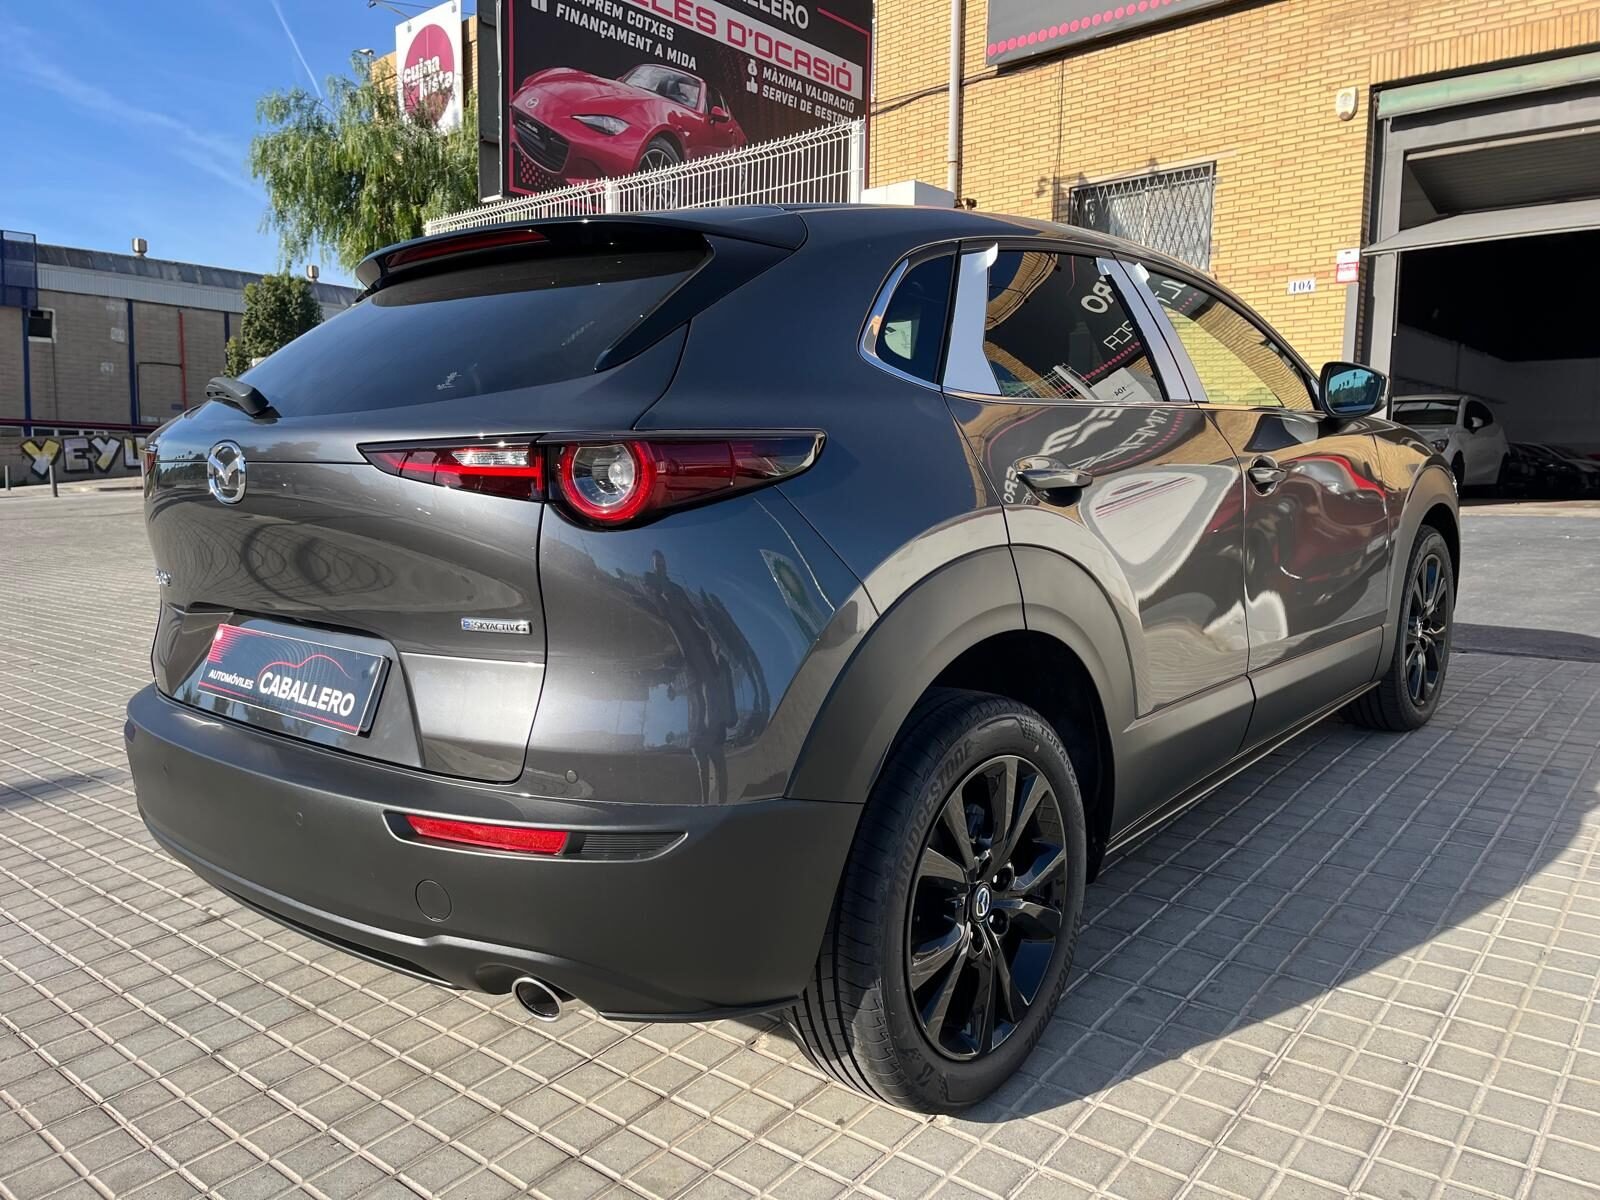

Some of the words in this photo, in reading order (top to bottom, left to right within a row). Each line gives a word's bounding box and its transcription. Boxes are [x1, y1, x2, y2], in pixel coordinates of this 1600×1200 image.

[556, 3, 653, 52] FINANÇAMENT
[655, 43, 663, 57] A
[666, 47, 697, 70] MIDA
[627, 10, 675, 41] COTXES
[404, 56, 440, 84] cuina
[727, 18, 852, 92] D'OCASIÓ
[762, 85, 797, 109] SERVEI
[800, 99, 812, 114] DE
[763, 66, 802, 93] MÀXIMA
[805, 83, 855, 113] VALORACIÓ
[1293, 280, 1312, 292] 104
[208, 669, 255, 690] AUTOMÓVILES
[258, 671, 355, 717] CABALLERO
